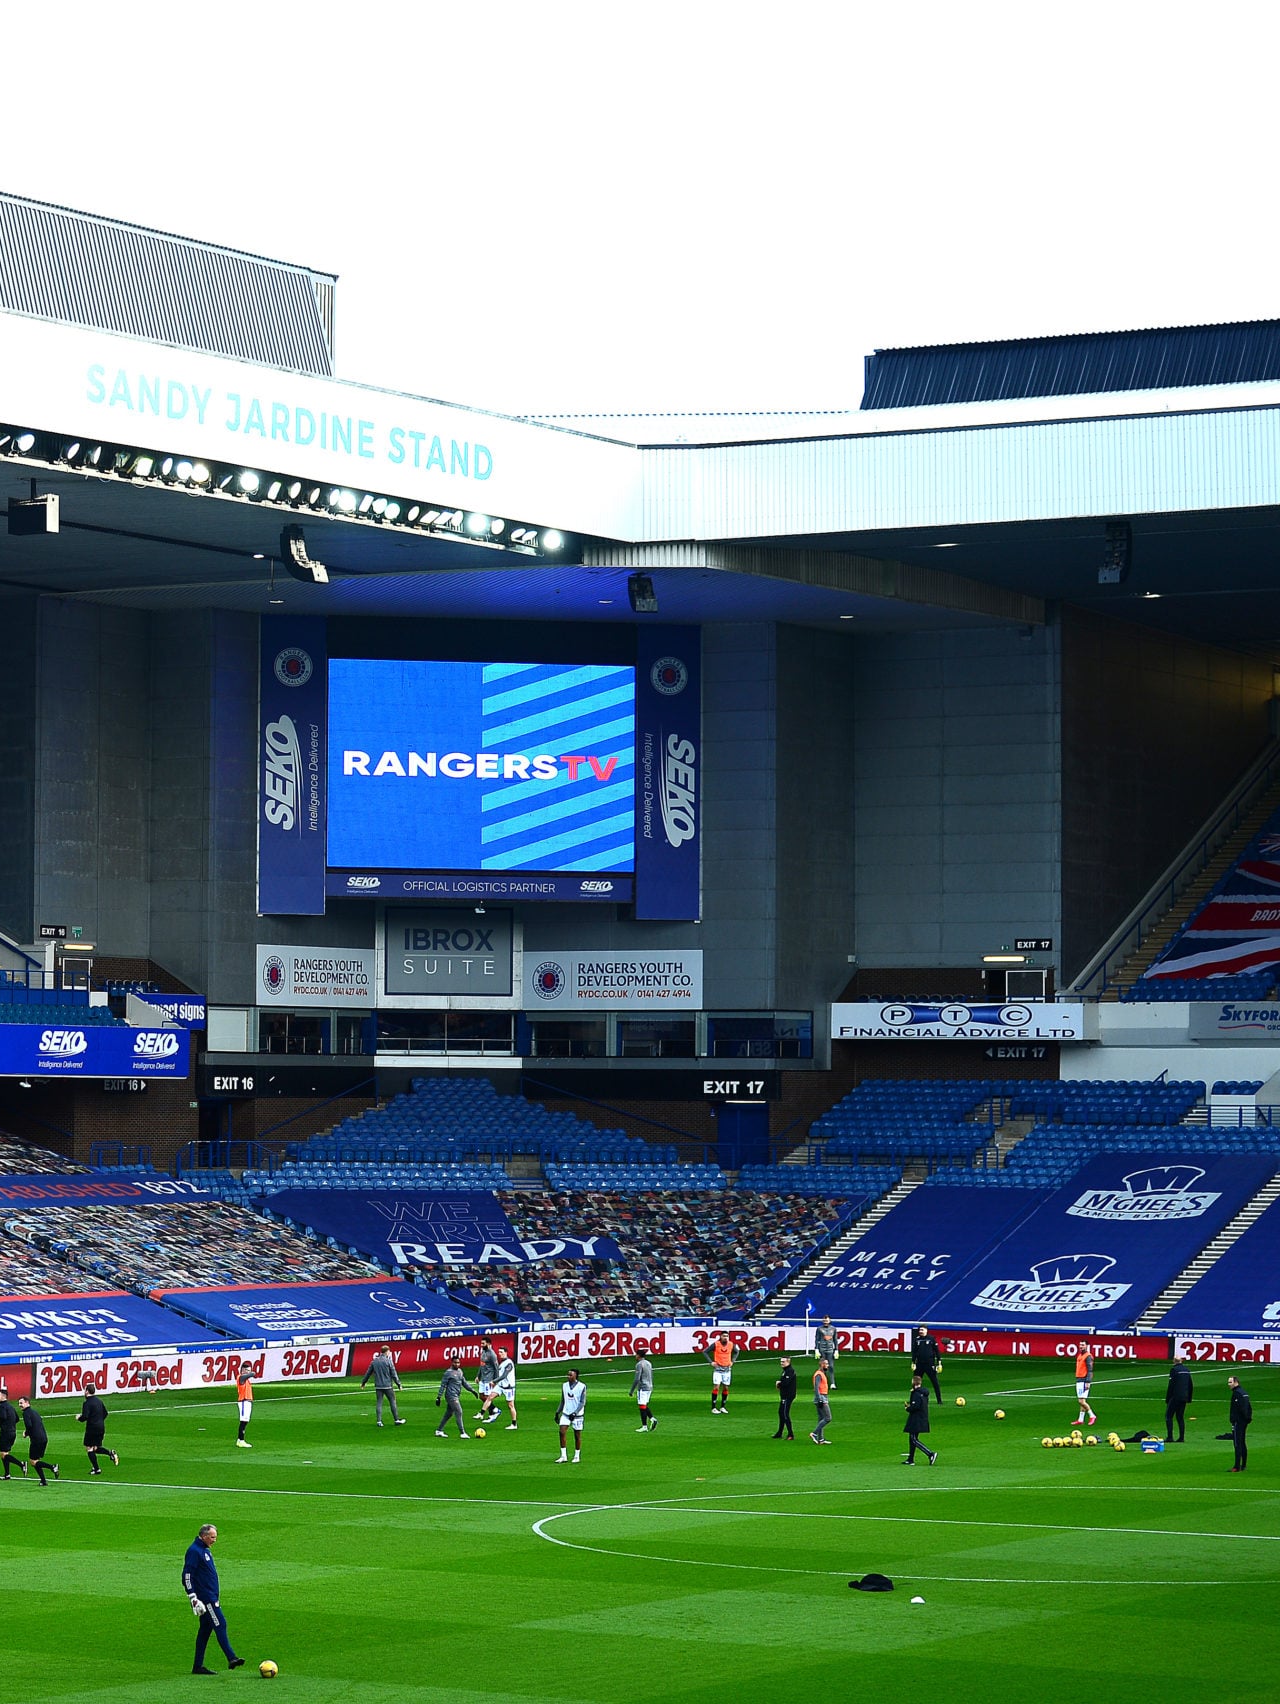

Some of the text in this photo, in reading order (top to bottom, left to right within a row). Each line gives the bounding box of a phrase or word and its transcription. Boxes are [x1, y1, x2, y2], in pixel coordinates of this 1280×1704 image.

[86, 364, 494, 482] SANDY JARDINE STAND
[265, 715, 297, 831] SEKO
[309, 724, 320, 831] Intelligence Delivered
[643, 733, 653, 838] Intelligence Delivered
[668, 734, 696, 848] SEKO
[347, 876, 381, 888] SEKO
[403, 881, 556, 893] OFFICIAL LOGISTICS PARTNER
[580, 880, 614, 892] SEKO
[41, 927, 56, 936] EXIT
[404, 928, 494, 951] IBROX
[1017, 941, 1050, 949] EXIT 17
[294, 958, 363, 972] RANGERS YOUTH
[403, 959, 495, 975] SUITE
[577, 962, 683, 974] RANGERS YOUTH
[294, 971, 369, 985] DEVELOPMENT CO.
[577, 975, 694, 987] DEVELOPMENT CO.
[294, 986, 368, 996] RYDC.CO.UK 0141 427 4914
[577, 990, 691, 998] RYDC.CO.UK 0141 427 4914
[179, 1002, 205, 1021] signs
[1218, 1004, 1280, 1021] SKYFOR
[839, 1026, 1075, 1038] FINANCIAL ADVICE LTD
[38, 1030, 87, 1055] SEKO
[133, 1033, 180, 1055] SEKO
[997, 1048, 1045, 1058] EXIT 17
[104, 1080, 138, 1091] EXIT 16
[214, 1077, 254, 1090] EXIT 16
[703, 1081, 765, 1094] EXIT 17
[132, 1180, 210, 1195] 1872
[367, 1200, 478, 1221] WE
[1077, 1209, 1195, 1220] FAMILY BAKERS
[386, 1221, 514, 1242] ARE
[388, 1236, 601, 1264] READY
[849, 1251, 952, 1266] MARC
[822, 1267, 946, 1282] DARCY
[827, 1282, 914, 1291] MENSWEAR
[980, 1300, 1101, 1312] FAMILY BAKERS
[17, 1327, 140, 1348] TIRES
[416, 1345, 483, 1362] IN CONTR
[521, 1333, 580, 1361] 32Red
[588, 1331, 666, 1356] 32Red
[836, 1331, 904, 1352] 2Red
[946, 1339, 1137, 1359] STAY IN COTROL
[1180, 1341, 1271, 1363] 32Red
[40, 1363, 108, 1394] 32Red
[116, 1358, 183, 1388] 32Red
[281, 1348, 344, 1375] 32Red
